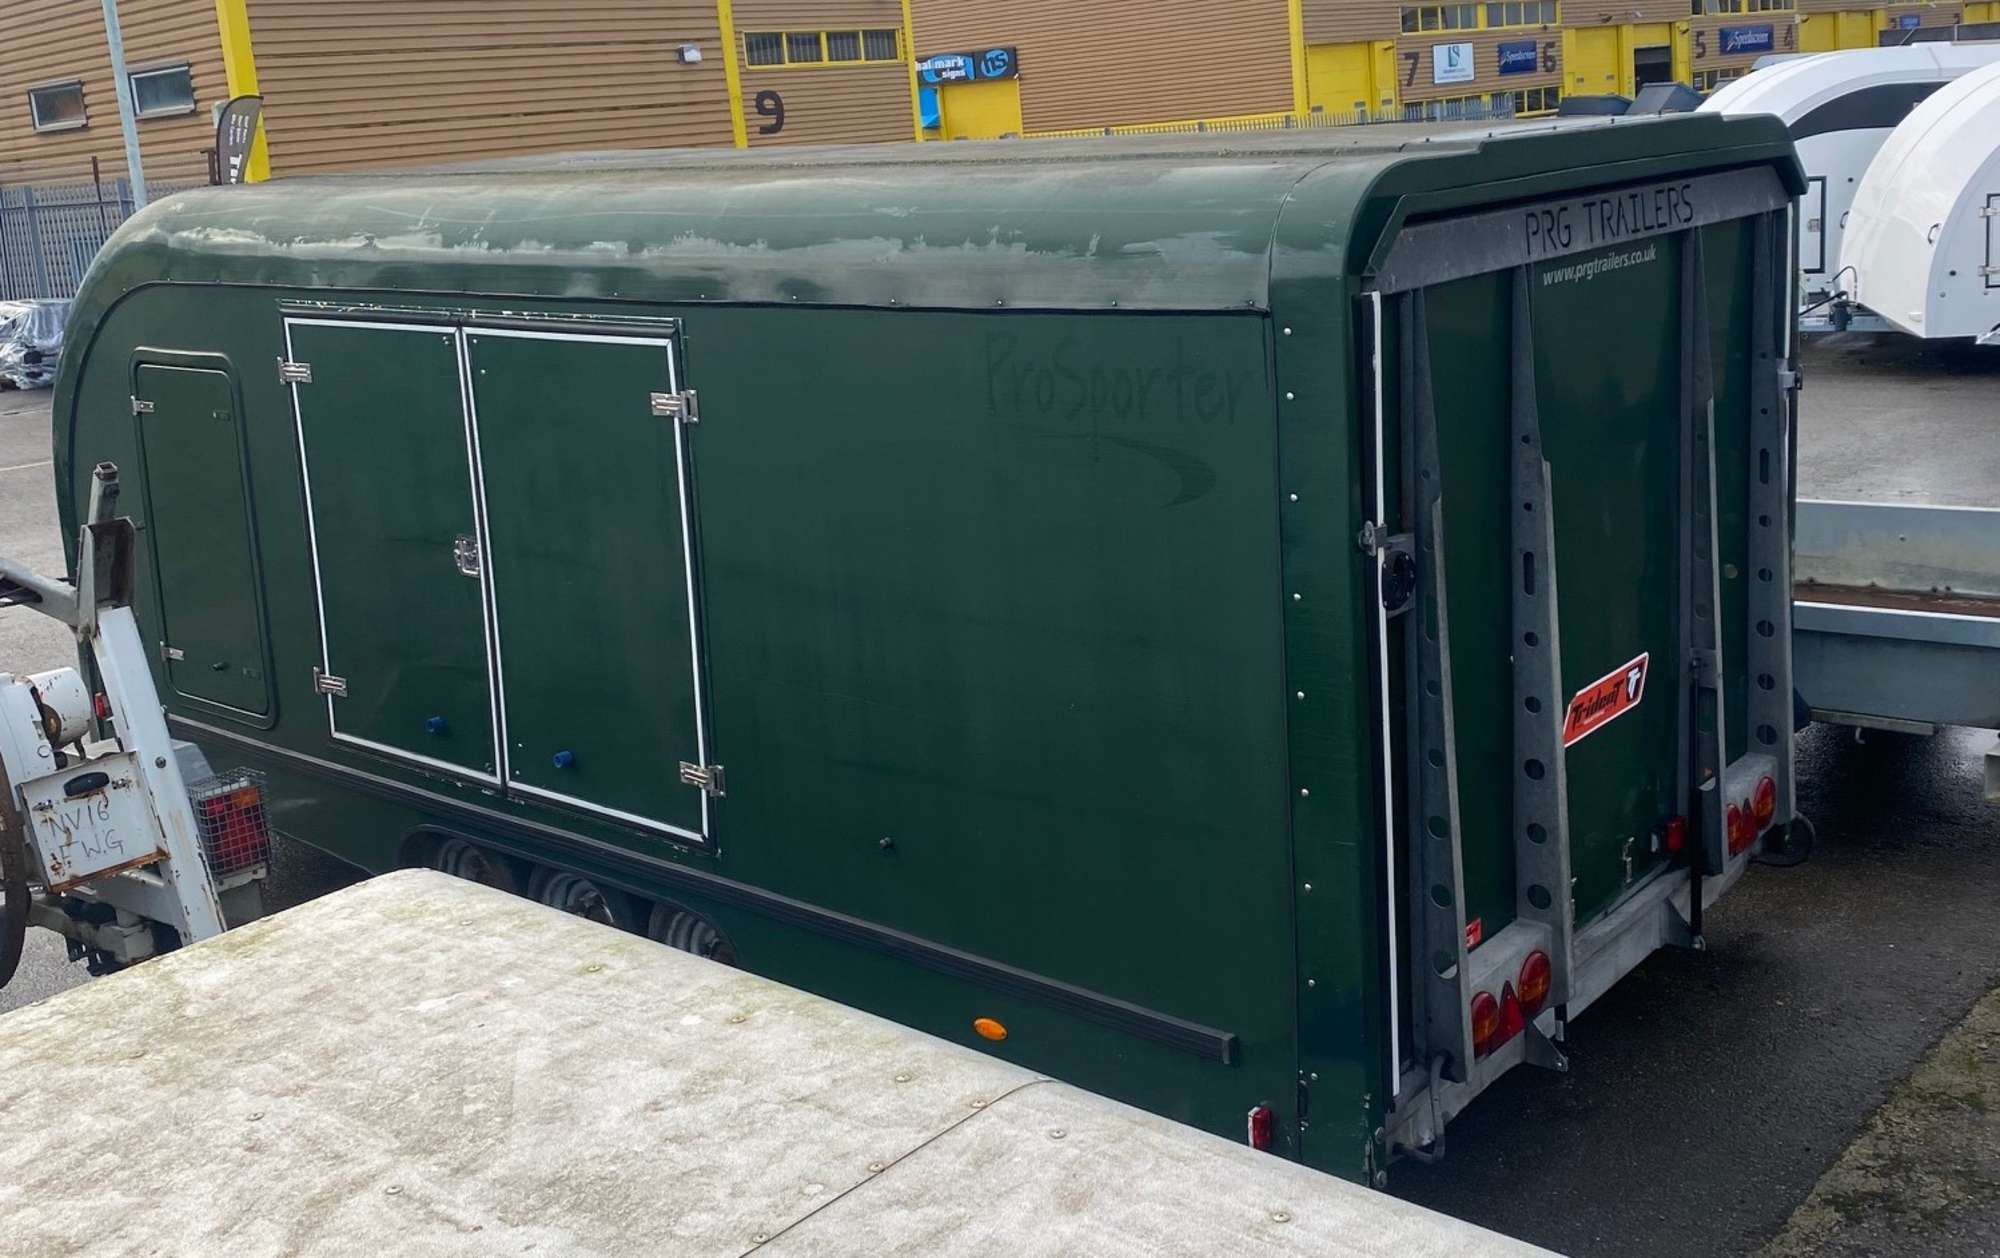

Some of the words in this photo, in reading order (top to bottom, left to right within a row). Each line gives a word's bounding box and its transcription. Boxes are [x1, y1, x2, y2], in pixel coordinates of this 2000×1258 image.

[1542, 42, 1557, 73] 6
[1695, 31, 1707, 58] 5
[1403, 52, 1420, 86] 7
[755, 90, 785, 135] 9
[1525, 207, 1571, 256] PRG
[1583, 184, 1694, 243] TRAILERS
[1543, 244, 1656, 286] www.prgtrailers.co.uk
[48, 800, 110, 837] NV16
